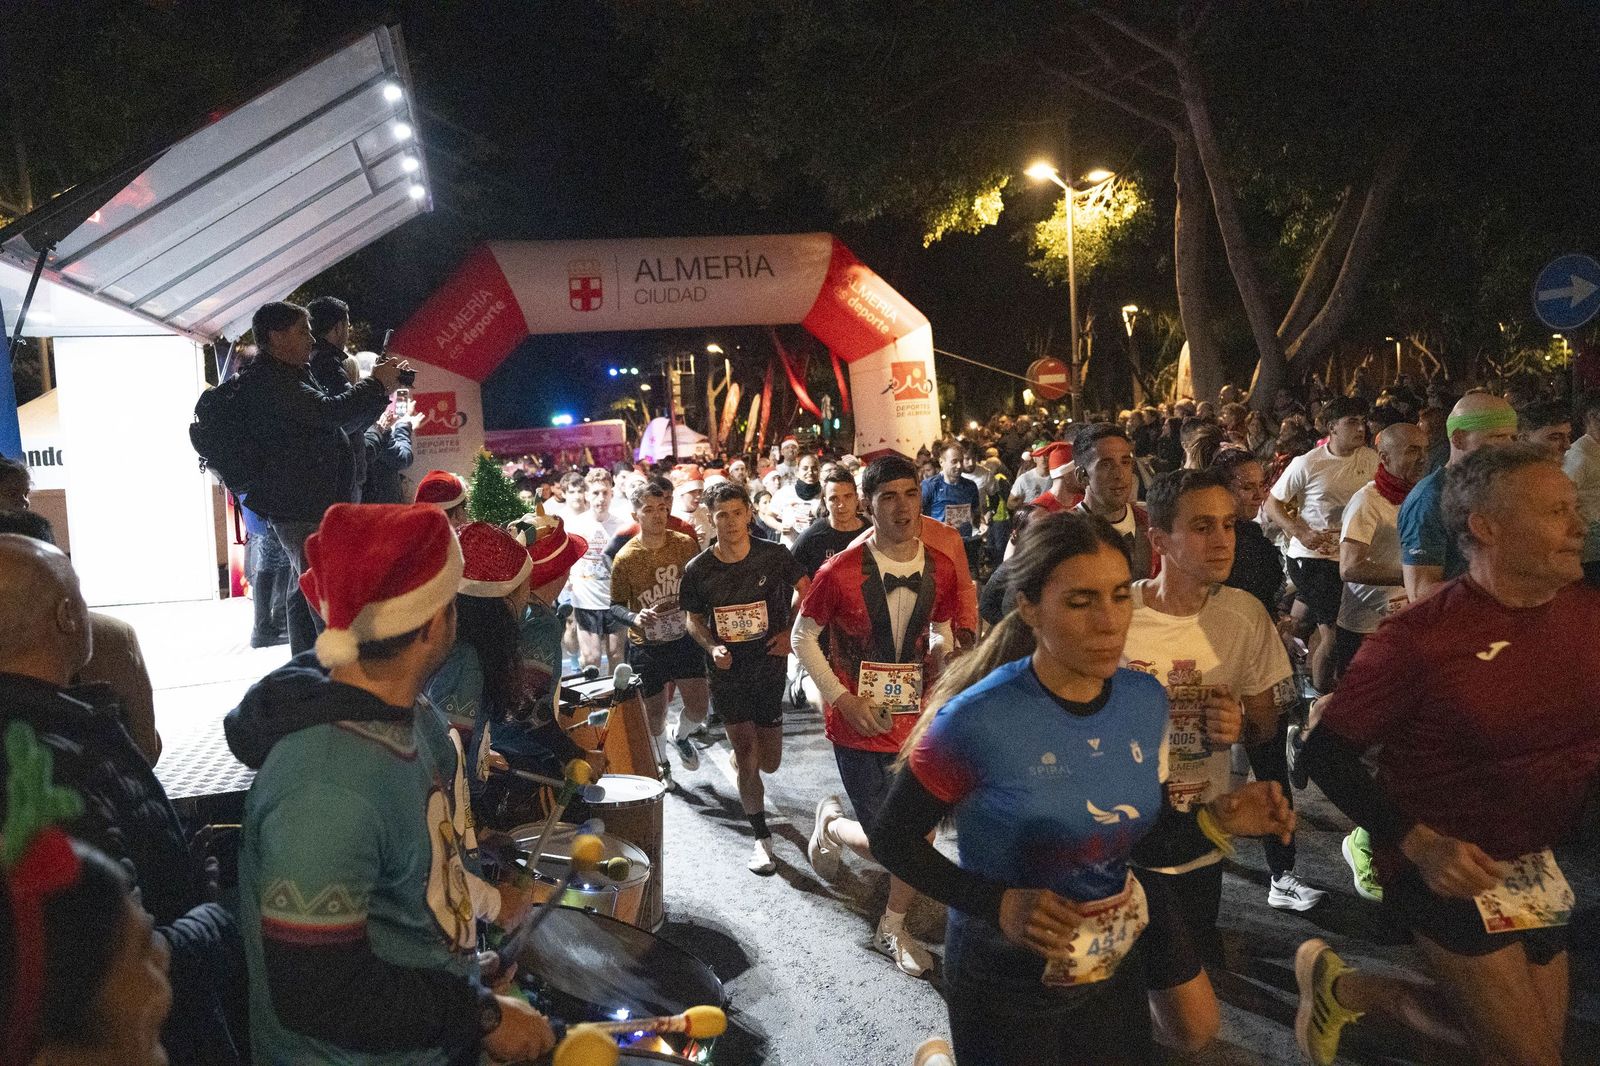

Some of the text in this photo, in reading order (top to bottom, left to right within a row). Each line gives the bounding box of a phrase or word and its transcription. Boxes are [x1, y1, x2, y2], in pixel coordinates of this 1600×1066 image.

[634, 250, 775, 283] ALMERÍA
[634, 287, 707, 305] CIUDAD
[462, 300, 506, 346] deporte
[847, 294, 890, 335] deporte
[655, 563, 678, 585] GO
[731, 619, 753, 629] 989
[884, 683, 902, 695] 98
